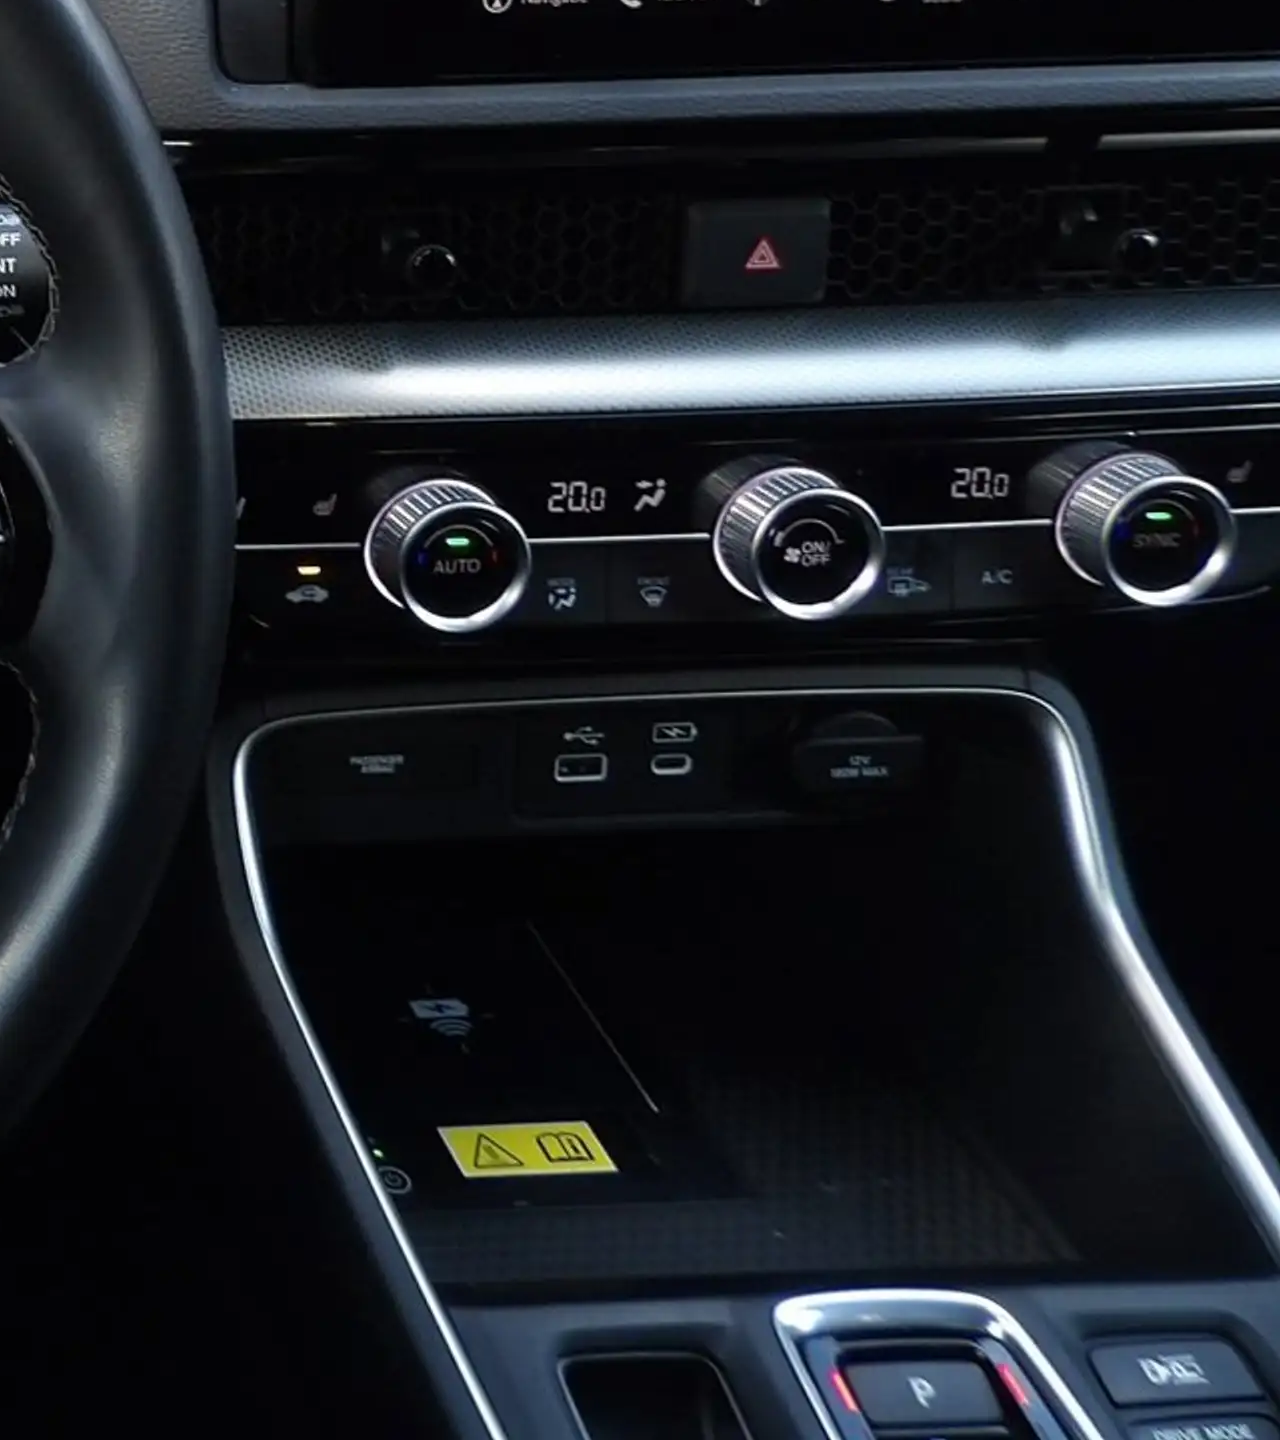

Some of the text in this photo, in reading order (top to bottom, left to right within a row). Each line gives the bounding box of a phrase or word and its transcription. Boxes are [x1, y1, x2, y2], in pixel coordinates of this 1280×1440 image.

[950, 466, 1010, 499] 20.0
[547, 480, 606, 513] 20.0
[1132, 534, 1182, 548] SYNC
[433, 558, 482, 575] AUTO
[981, 569, 1012, 585] A/C
[907, 1376, 936, 1408] P
